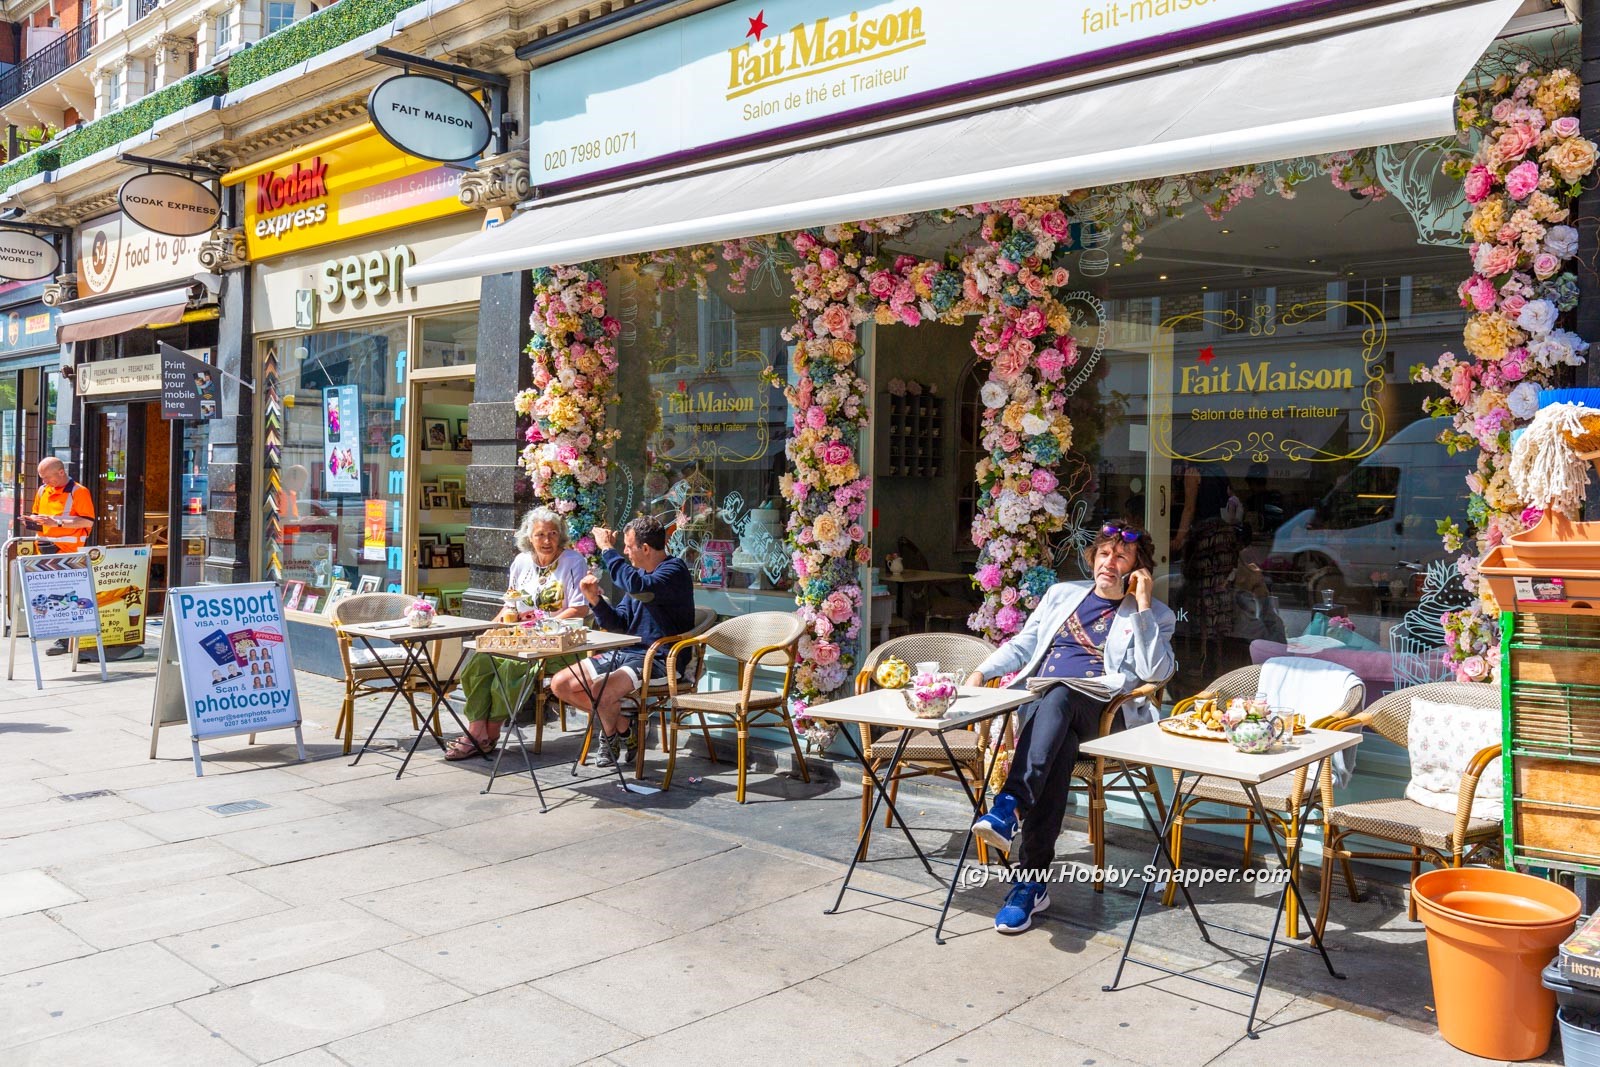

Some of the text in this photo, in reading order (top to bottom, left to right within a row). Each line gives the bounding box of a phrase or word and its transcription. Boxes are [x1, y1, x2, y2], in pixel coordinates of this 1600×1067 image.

[728, 6, 926, 90] Fait Maison
[743, 65, 909, 121] Salon de thé et Traiteur
[392, 103, 473, 129] FAIT MAISON
[545, 130, 636, 171] 020 7998 0071
[256, 156, 328, 213] Kodak
[363, 172, 463, 208] Digital Solution
[126, 195, 216, 216] KODAK EXPRESS
[255, 202, 327, 237] express
[0, 247, 43, 258] ANDWICH
[0, 255, 35, 264] WORLD
[93, 241, 107, 266] 54
[125, 237, 150, 271] food
[156, 237, 167, 262] to
[320, 244, 415, 303] seen
[165, 361, 185, 370] Print
[165, 371, 186, 379] from
[1179, 361, 1354, 395] Fait Maison
[164, 381, 184, 390] your
[165, 390, 195, 399] mobile
[697, 391, 754, 413] Maison
[165, 400, 185, 409] here
[1191, 405, 1339, 421] Salon de thé et Traiteur
[94, 562, 137, 572] Breakfast
[100, 570, 130, 578] Special
[27, 570, 88, 582] picture framing
[180, 590, 276, 621] Passport
[33, 612, 45, 620] cine
[52, 610, 70, 618] video
[242, 613, 279, 625] photos
[256, 633, 282, 641] APPROVED
[215, 683, 247, 694] Scan &
[195, 689, 291, 718] photocopy
[202, 708, 287, 723] seengr@seenphotos.com
[224, 719, 239, 727] 0207
[1571, 962, 1600, 978] INSTA
